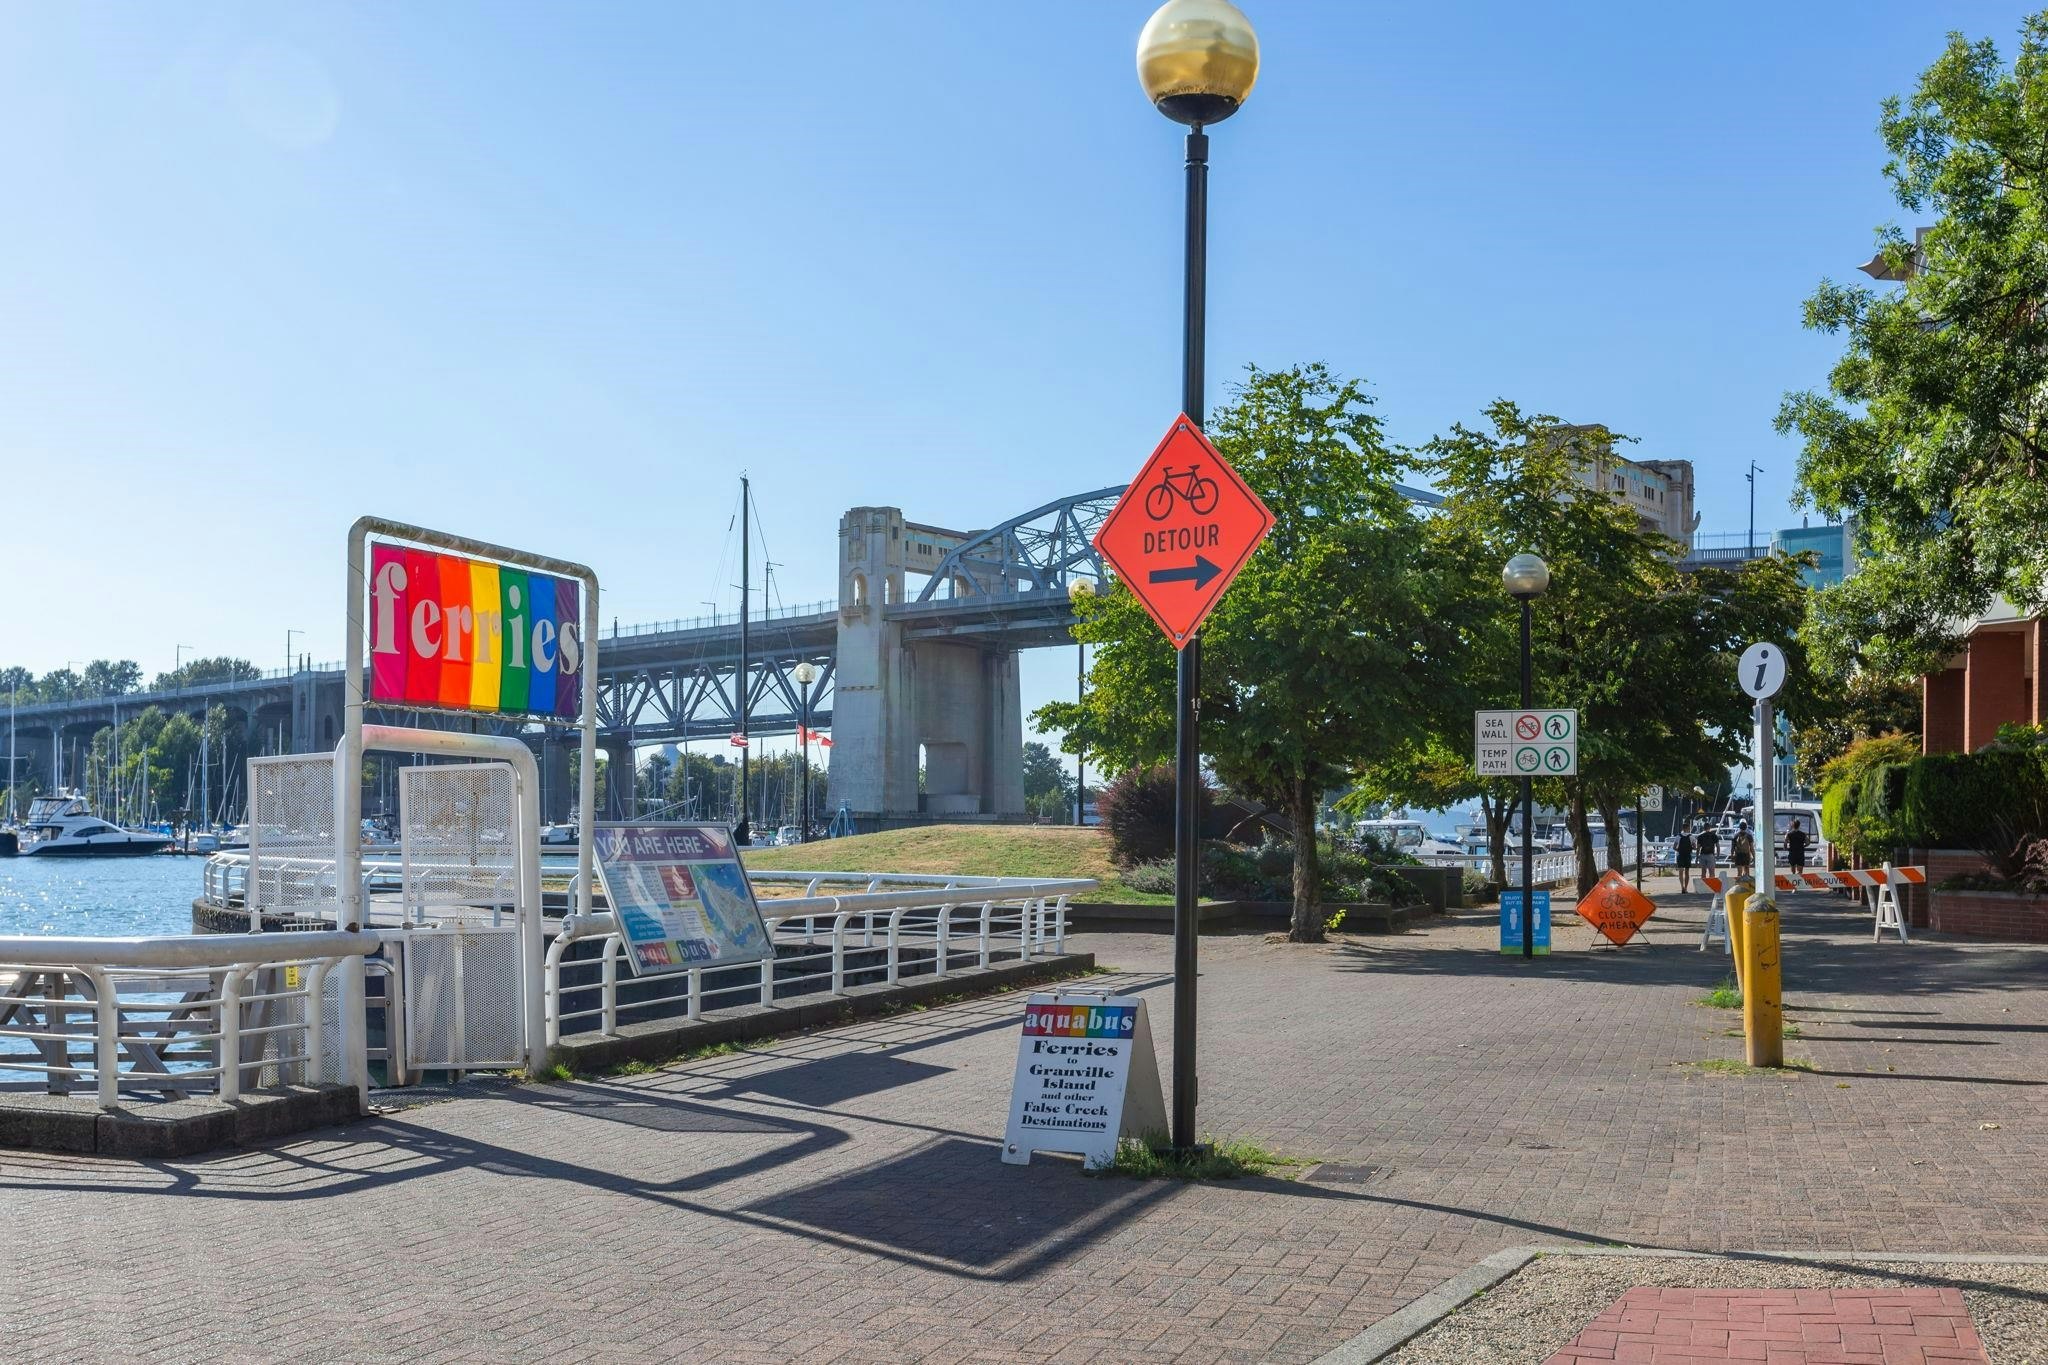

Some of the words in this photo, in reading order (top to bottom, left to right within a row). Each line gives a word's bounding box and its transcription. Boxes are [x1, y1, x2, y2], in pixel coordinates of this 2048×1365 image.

[1143, 524, 1219, 554] DETOUR
[372, 562, 579, 675] ferries
[1194, 711, 1200, 721] 7
[1485, 719, 1504, 728] SEA
[1481, 731, 1507, 739] WALL
[1482, 750, 1508, 758] TEMP
[1482, 761, 1507, 769] PATH
[596, 837, 631, 855] YOU
[633, 837, 665, 855] ARE
[664, 836, 704, 854] HERE
[1598, 911, 1636, 919] CLOSED
[1600, 921, 1636, 930] AHEAD
[637, 943, 707, 963] aqubus
[1025, 1008, 1133, 1034] aquabus
[1032, 1040, 1119, 1057] Ferries
[1029, 1064, 1115, 1078] Granville
[1042, 1078, 1096, 1091] Island
[1041, 1092, 1061, 1100] and
[1064, 1092, 1095, 1102] other
[1024, 1102, 1061, 1113] False
[1065, 1103, 1108, 1116] Creek
[1021, 1115, 1107, 1129] Destinations
